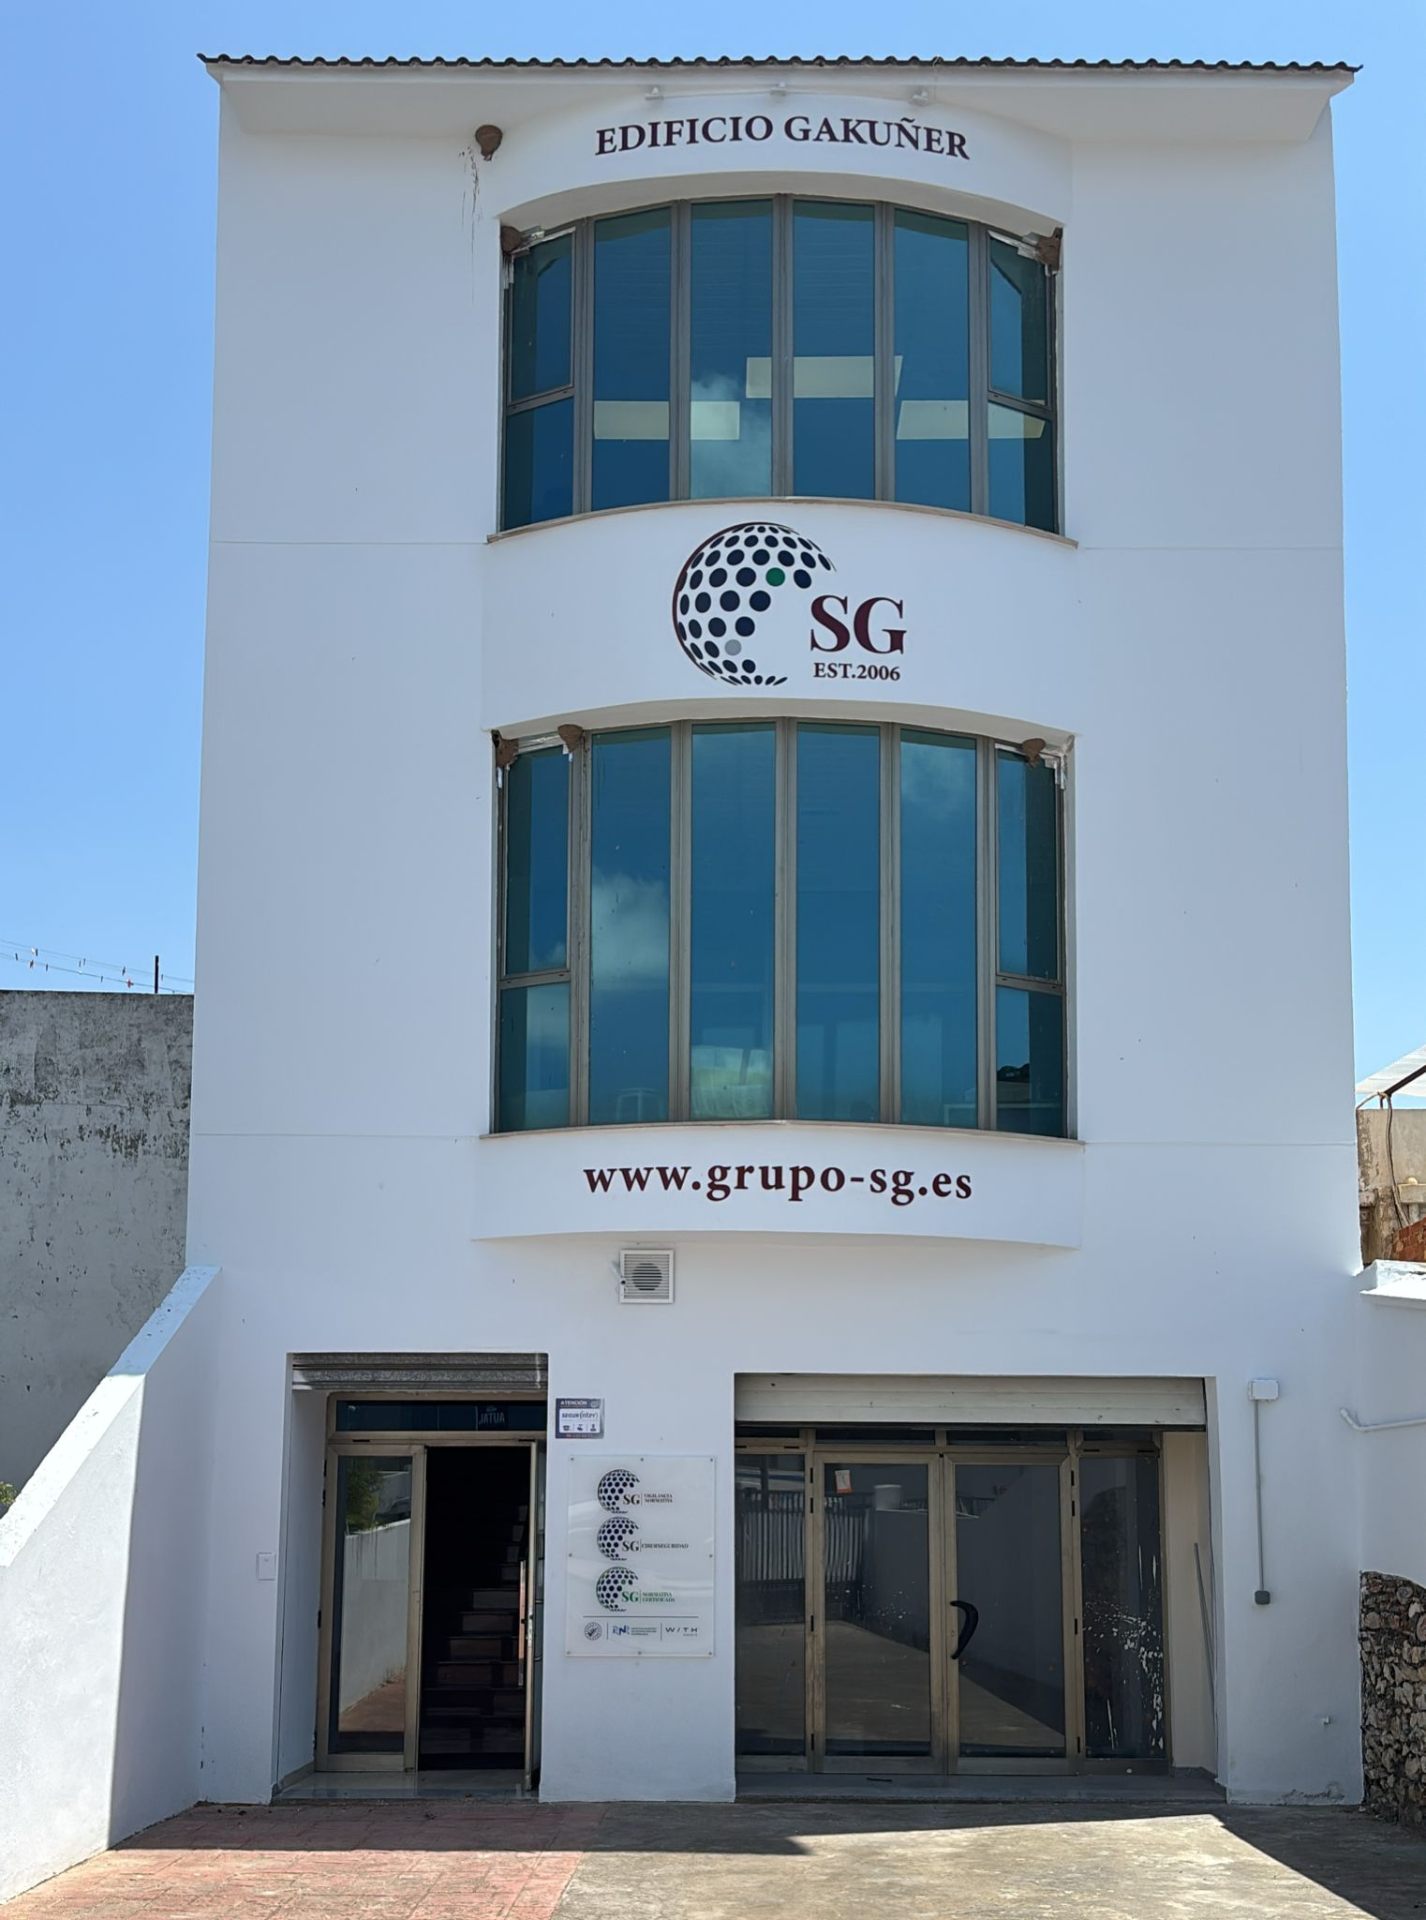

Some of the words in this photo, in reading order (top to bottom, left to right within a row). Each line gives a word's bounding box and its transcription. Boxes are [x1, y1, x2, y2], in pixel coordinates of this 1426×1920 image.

[595, 115, 774, 156] EDIFICIO
[783, 116, 971, 160] GAKUÑER
[811, 594, 907, 655] SG
[813, 662, 901, 682] EST.2006
[583, 1163, 972, 1206] www.grupo-sg.es
[623, 1493, 640, 1505] SG
[622, 1540, 640, 1552] SG
[621, 1591, 639, 1603] SG
